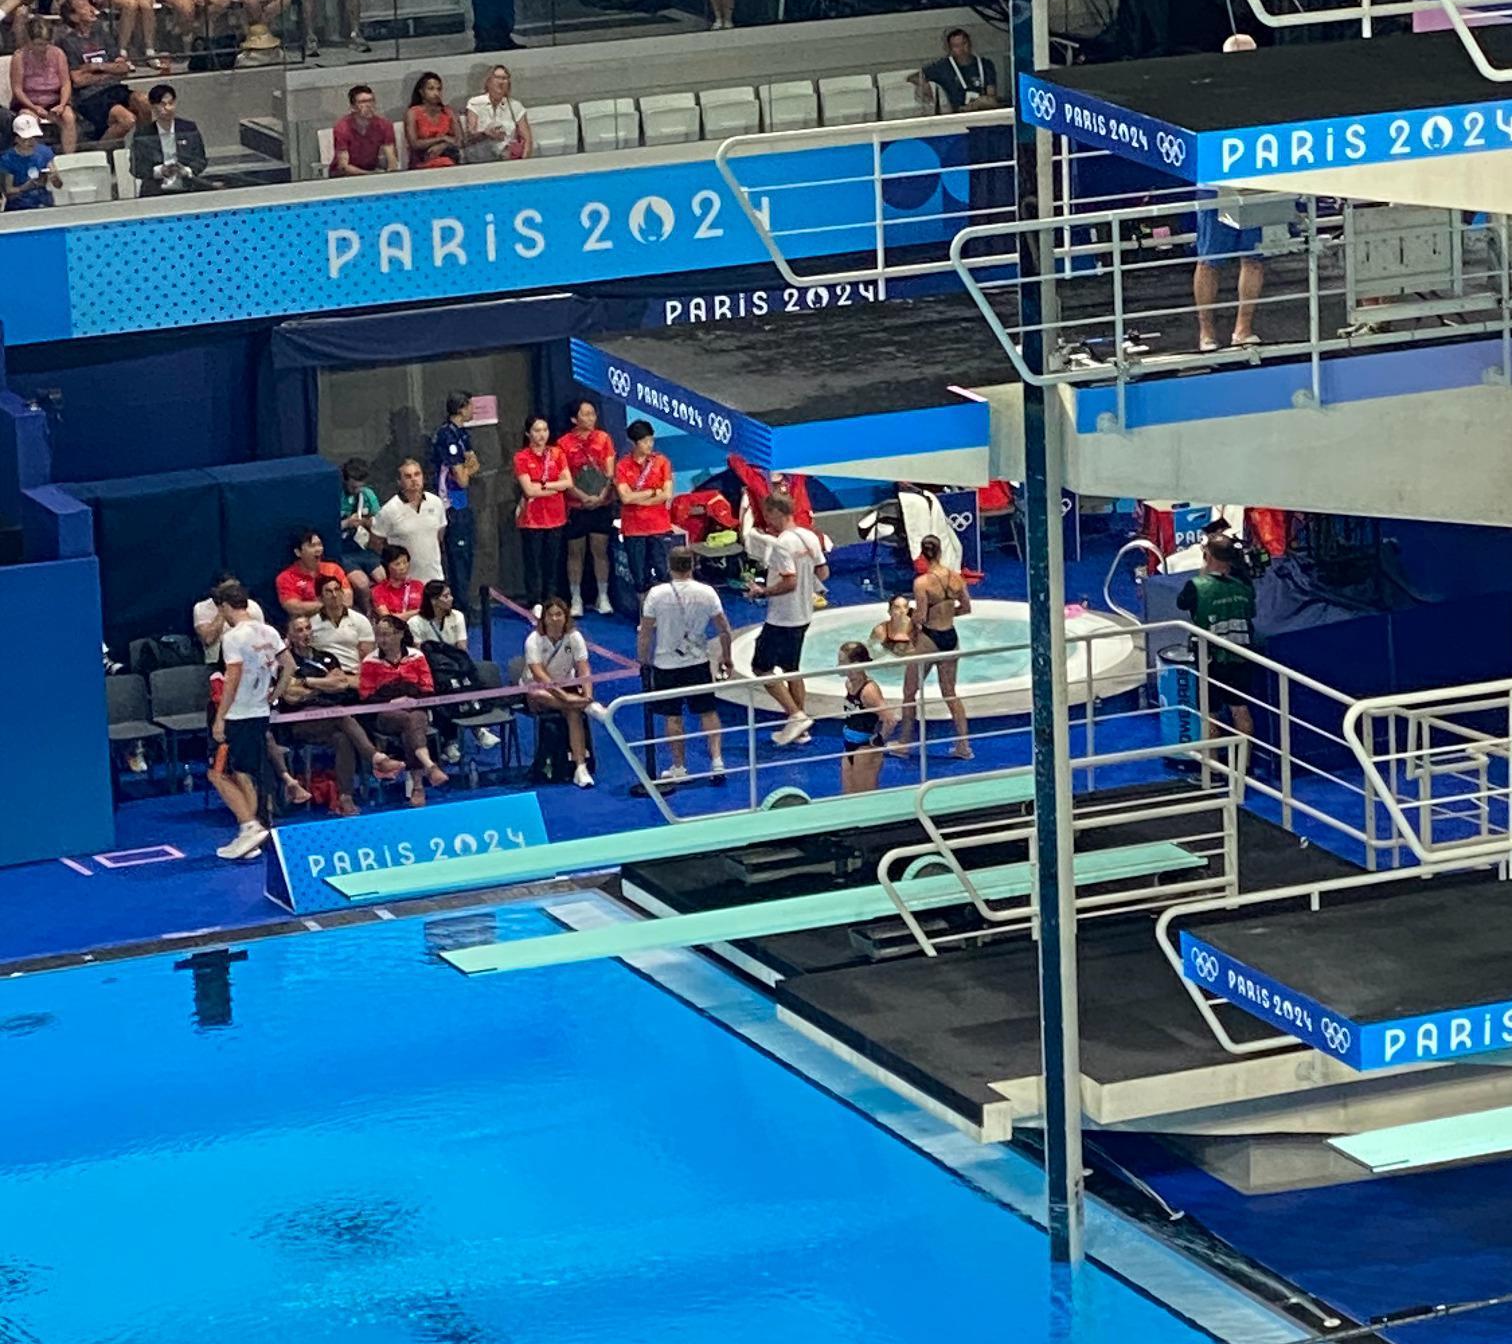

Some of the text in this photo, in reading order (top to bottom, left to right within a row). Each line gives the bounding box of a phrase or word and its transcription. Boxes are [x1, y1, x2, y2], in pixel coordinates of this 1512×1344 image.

[1109, 118, 1149, 152] 2024
[579, 189, 770, 253] 2024
[784, 284, 875, 311] 2024
[671, 399, 703, 429] 2024
[429, 827, 526, 862] 2024
[1273, 996, 1313, 1034] 2024
